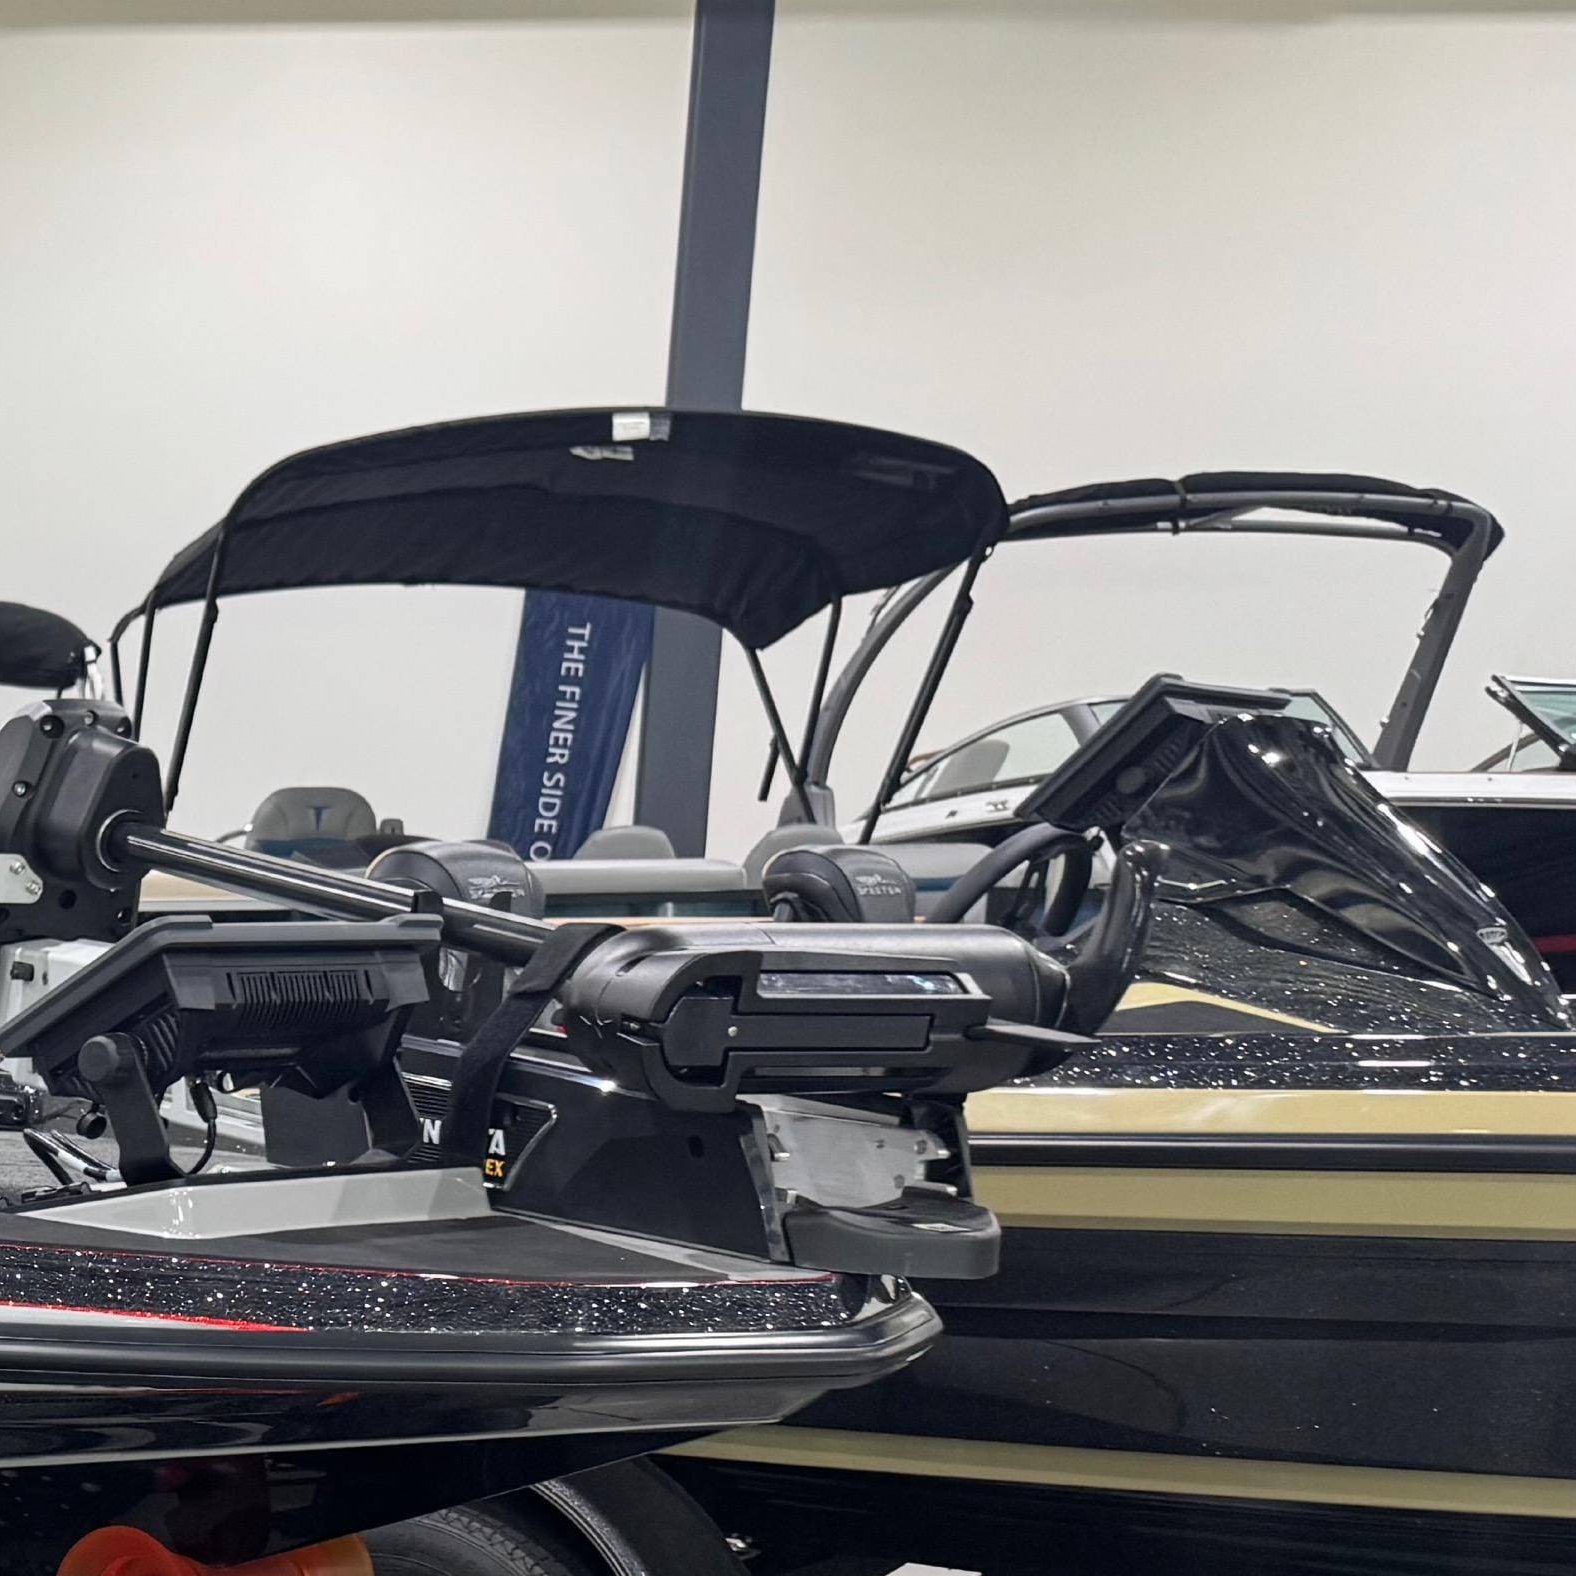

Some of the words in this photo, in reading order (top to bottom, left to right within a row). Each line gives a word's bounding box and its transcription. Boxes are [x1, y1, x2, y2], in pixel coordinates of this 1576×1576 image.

[560, 622, 591, 677] THE
[546, 684, 581, 764] FINER
[534, 771, 565, 835] SIDE
